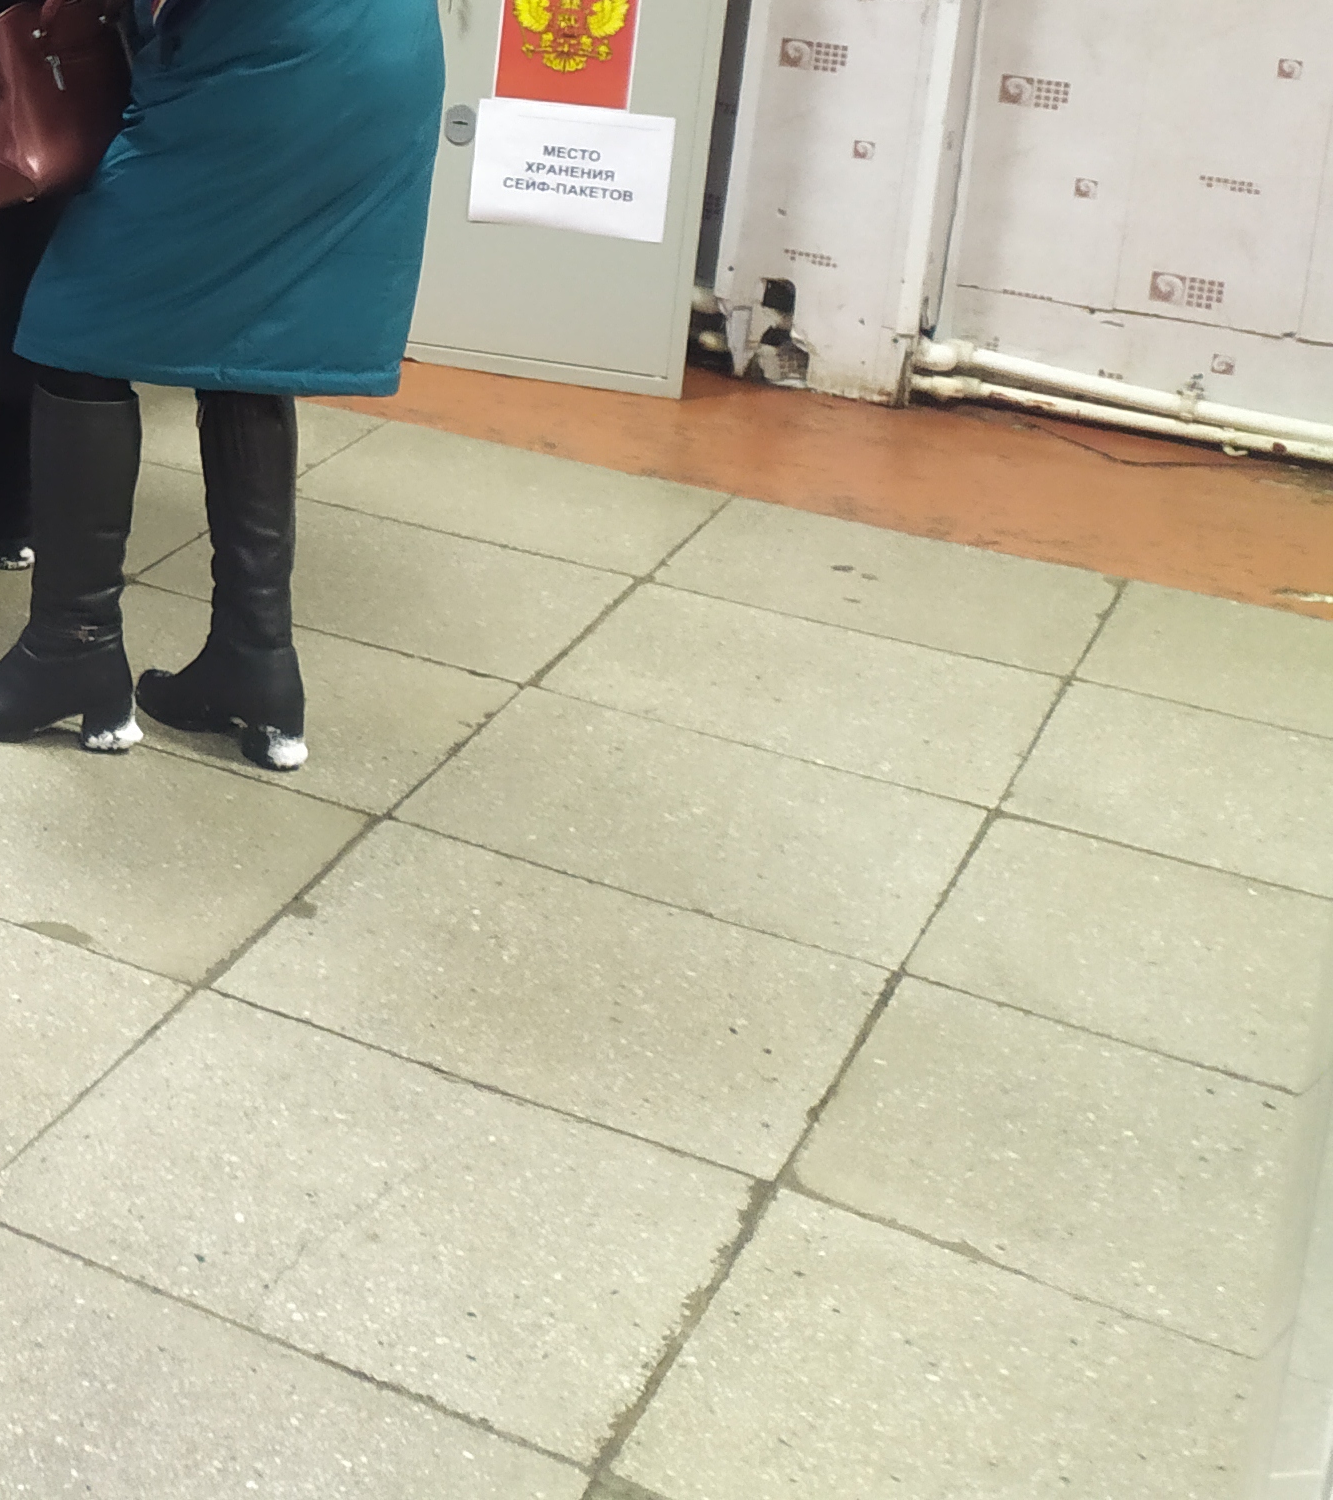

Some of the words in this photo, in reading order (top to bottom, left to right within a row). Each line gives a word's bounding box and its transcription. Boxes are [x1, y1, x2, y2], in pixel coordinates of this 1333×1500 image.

[543, 144, 601, 163] МЕСТО
[525, 162, 616, 182] ХРАНЕНИЯ
[503, 176, 633, 203] СЕЙФ-ПАКЕТОВ
